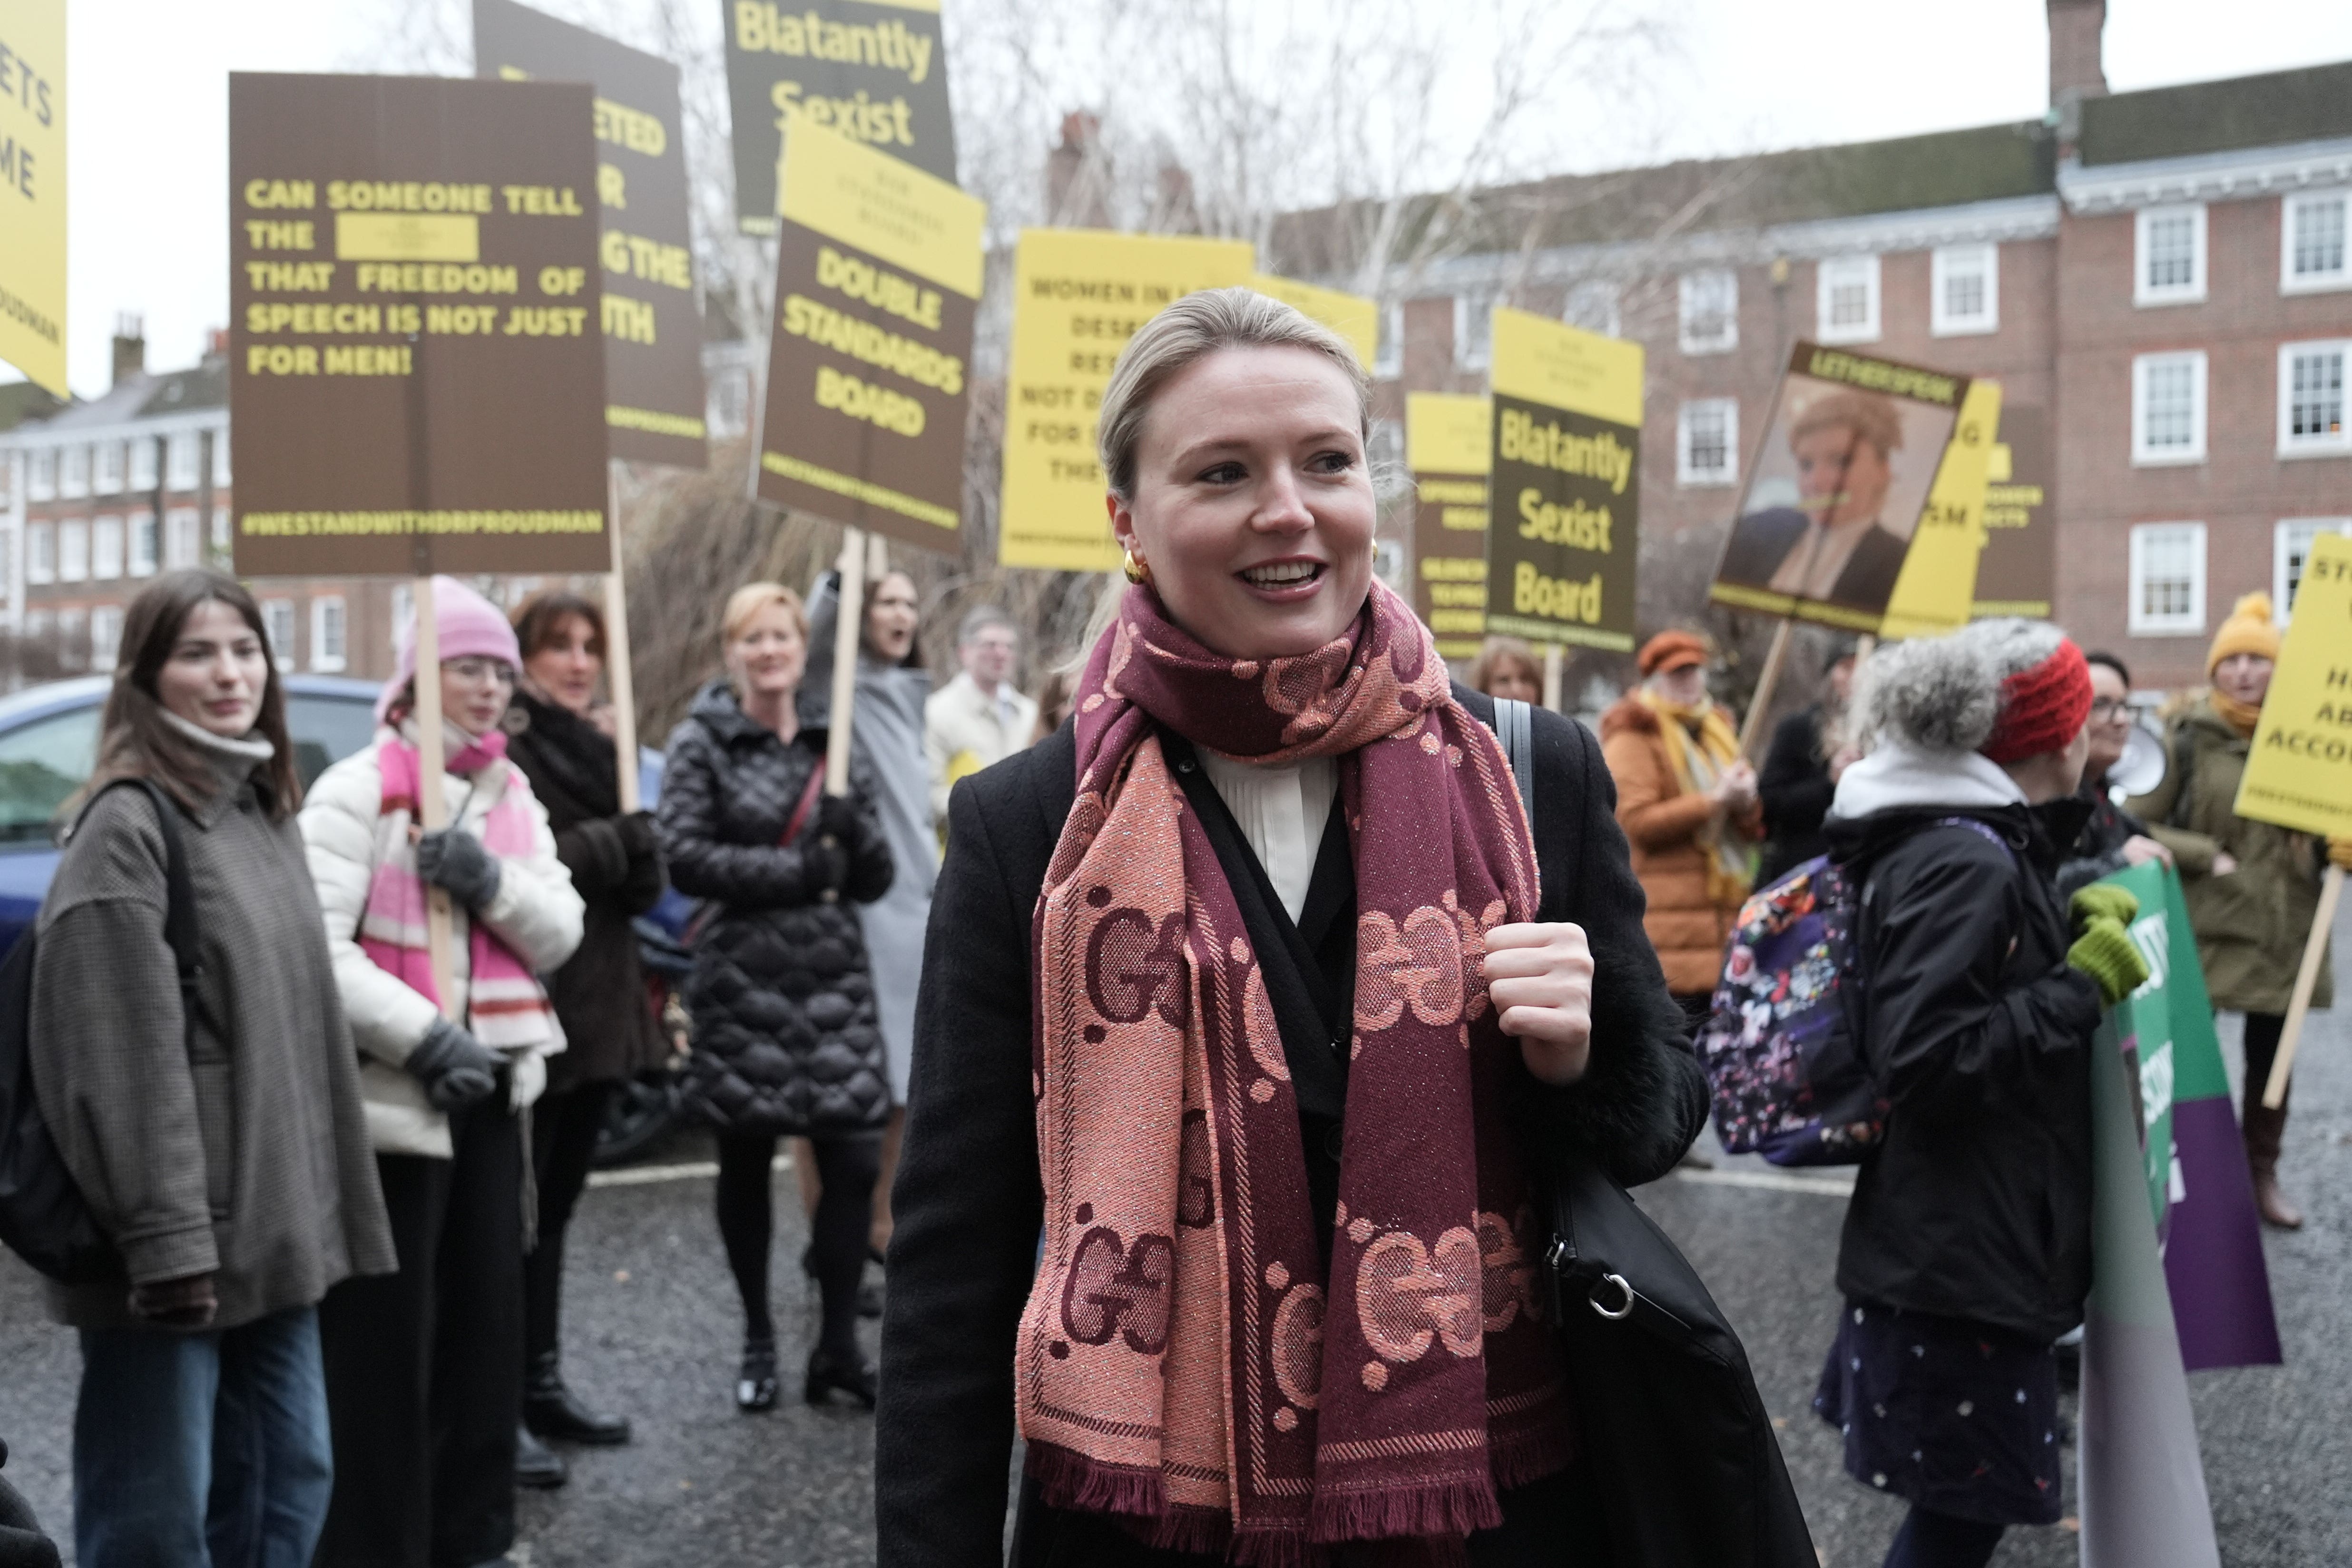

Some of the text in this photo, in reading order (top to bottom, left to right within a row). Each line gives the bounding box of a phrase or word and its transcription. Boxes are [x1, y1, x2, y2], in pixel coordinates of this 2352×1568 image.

[734, 0, 933, 84] Blatantly
[770, 80, 915, 147] Sexist
[245, 179, 583, 216] CAN SOMEONE TELL
[245, 220, 315, 250] THE
[245, 261, 585, 295] THAT FREEDOM OF
[817, 245, 942, 331] DOUBLE
[1029, 278, 1136, 303] WOMEN
[246, 304, 588, 336] SPEECH IS NOT JUST
[247, 345, 412, 376] FOR MEN!
[783, 293, 964, 396] STANDARDS
[815, 364, 926, 437] BOARD
[1021, 386, 1075, 408] NOT
[1027, 421, 1082, 445] FOR
[1500, 409, 1632, 495] Blatantly
[241, 510, 603, 536] #WESTANDWITHDRPROUDMAN
[1518, 487, 1612, 553] Sexist
[1514, 560, 1603, 625] Board
